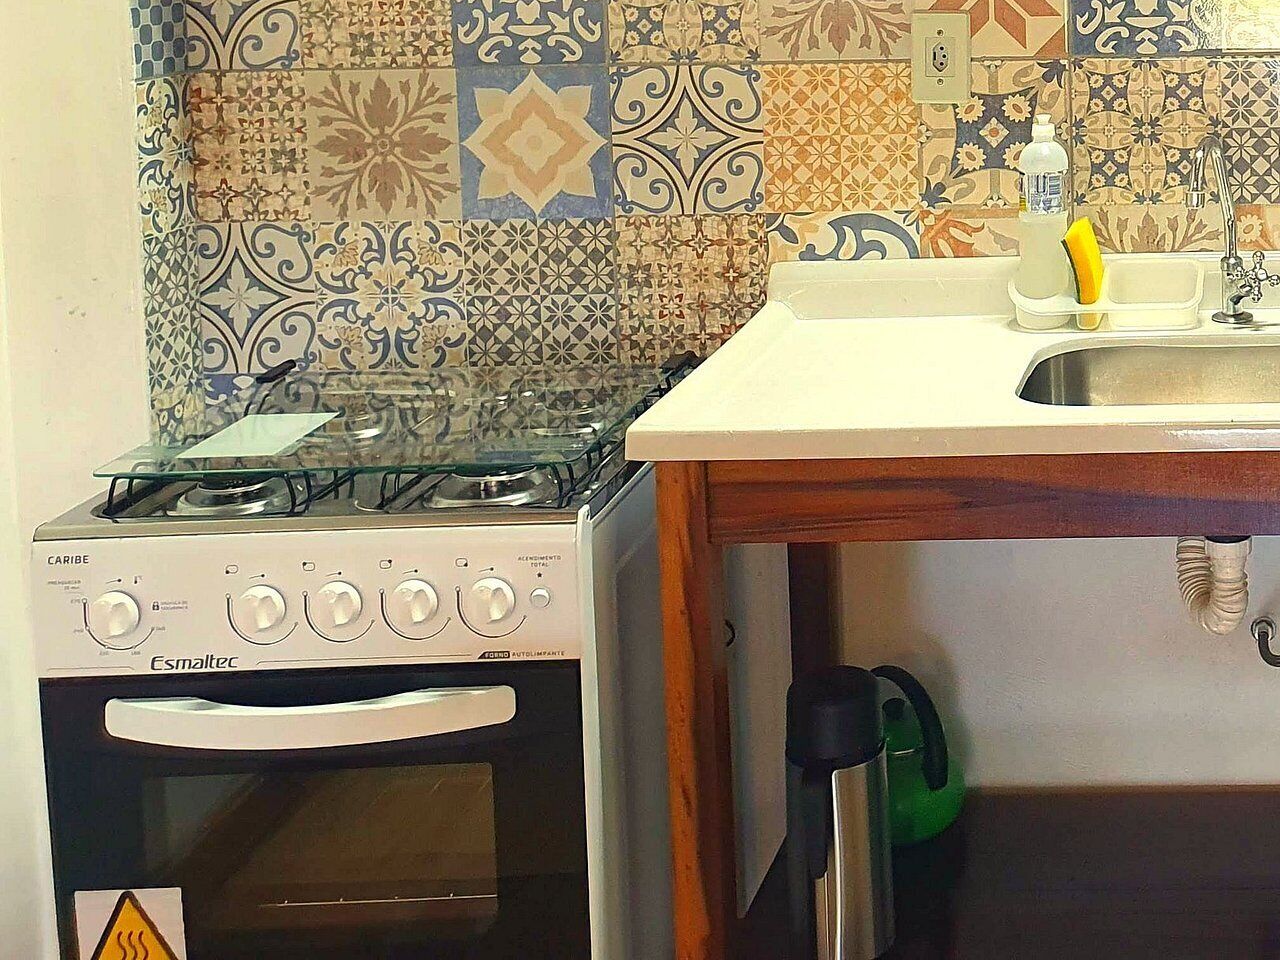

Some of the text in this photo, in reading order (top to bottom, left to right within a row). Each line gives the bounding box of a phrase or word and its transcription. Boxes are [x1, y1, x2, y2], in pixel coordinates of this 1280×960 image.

[47, 554, 89, 565] CARIBE
[511, 650, 565, 658] AUTOLIMPANTE
[150, 653, 239, 671] Esmaltec
